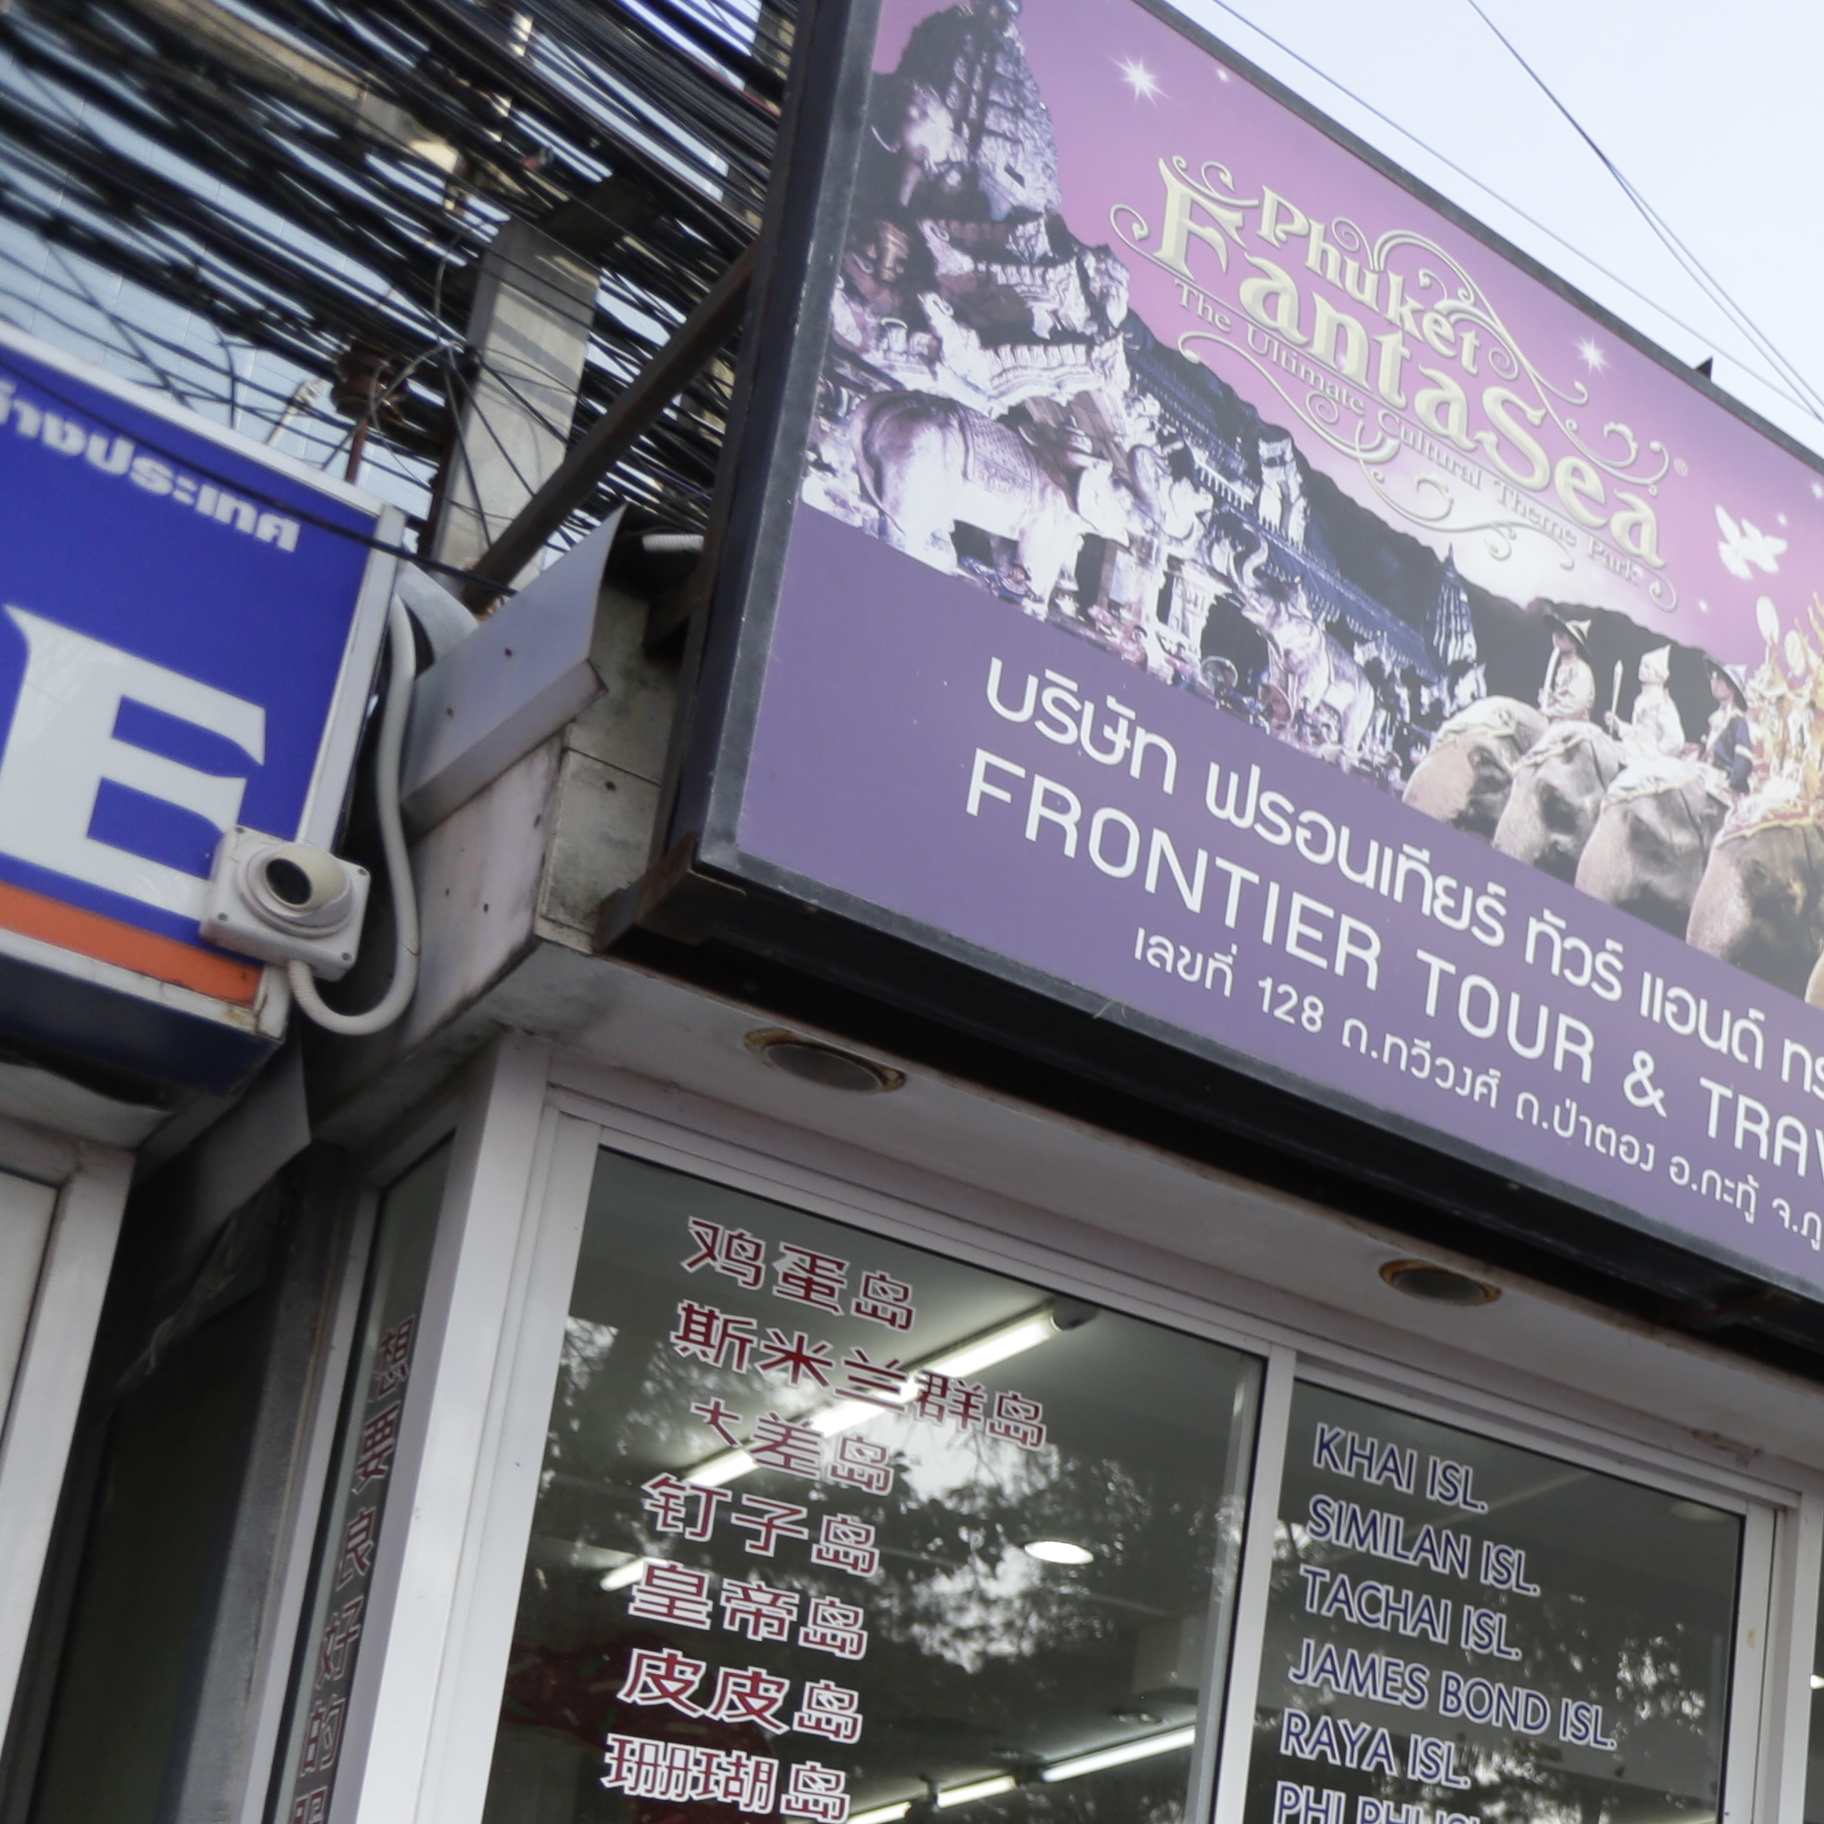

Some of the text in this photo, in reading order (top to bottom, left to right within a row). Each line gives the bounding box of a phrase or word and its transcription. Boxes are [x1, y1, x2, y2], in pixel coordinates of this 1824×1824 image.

[1255, 183, 1479, 376] Phuket
[1150, 155, 1668, 570] FantaSea
[1175, 282, 1643, 587] The Ultimate Cultural Theme Park
[986, 656, 1177, 795] บริษัท
[1204, 761, 1507, 947] ฟรอนเทียร์
[1525, 908, 1625, 1002] ทัวร์
[1639, 971, 1766, 1071] แอนด์
[965, 747, 1382, 991] FRONTIER
[1415, 948, 1596, 1084] TOUR
[1623, 1050, 1669, 1118] &
[1134, 926, 1240, 998] เลขที่
[1257, 975, 1325, 1034] 128
[1669, 1152, 1759, 1225] อ.กะทู้
[680, 1216, 915, 1332] 鸡蛋岛
[670, 1300, 1047, 1450] 斯米兰群岛
[1312, 1421, 1489, 1514] KHAI ISL.
[641, 1472, 881, 1578] 钉子岛
[1306, 1493, 1542, 1598] SIMILAN ISL.
[627, 1560, 868, 1661] 皇帝岛
[1298, 1565, 1523, 1662] TACHAI ISL.
[616, 1646, 864, 1745] 皮皮岛
[1279, 1706, 1472, 1790] RAYA ISL.
[1288, 1638, 1619, 1751] JAMES BOND ISL.
[604, 1733, 850, 1823] 珊瑚岛
